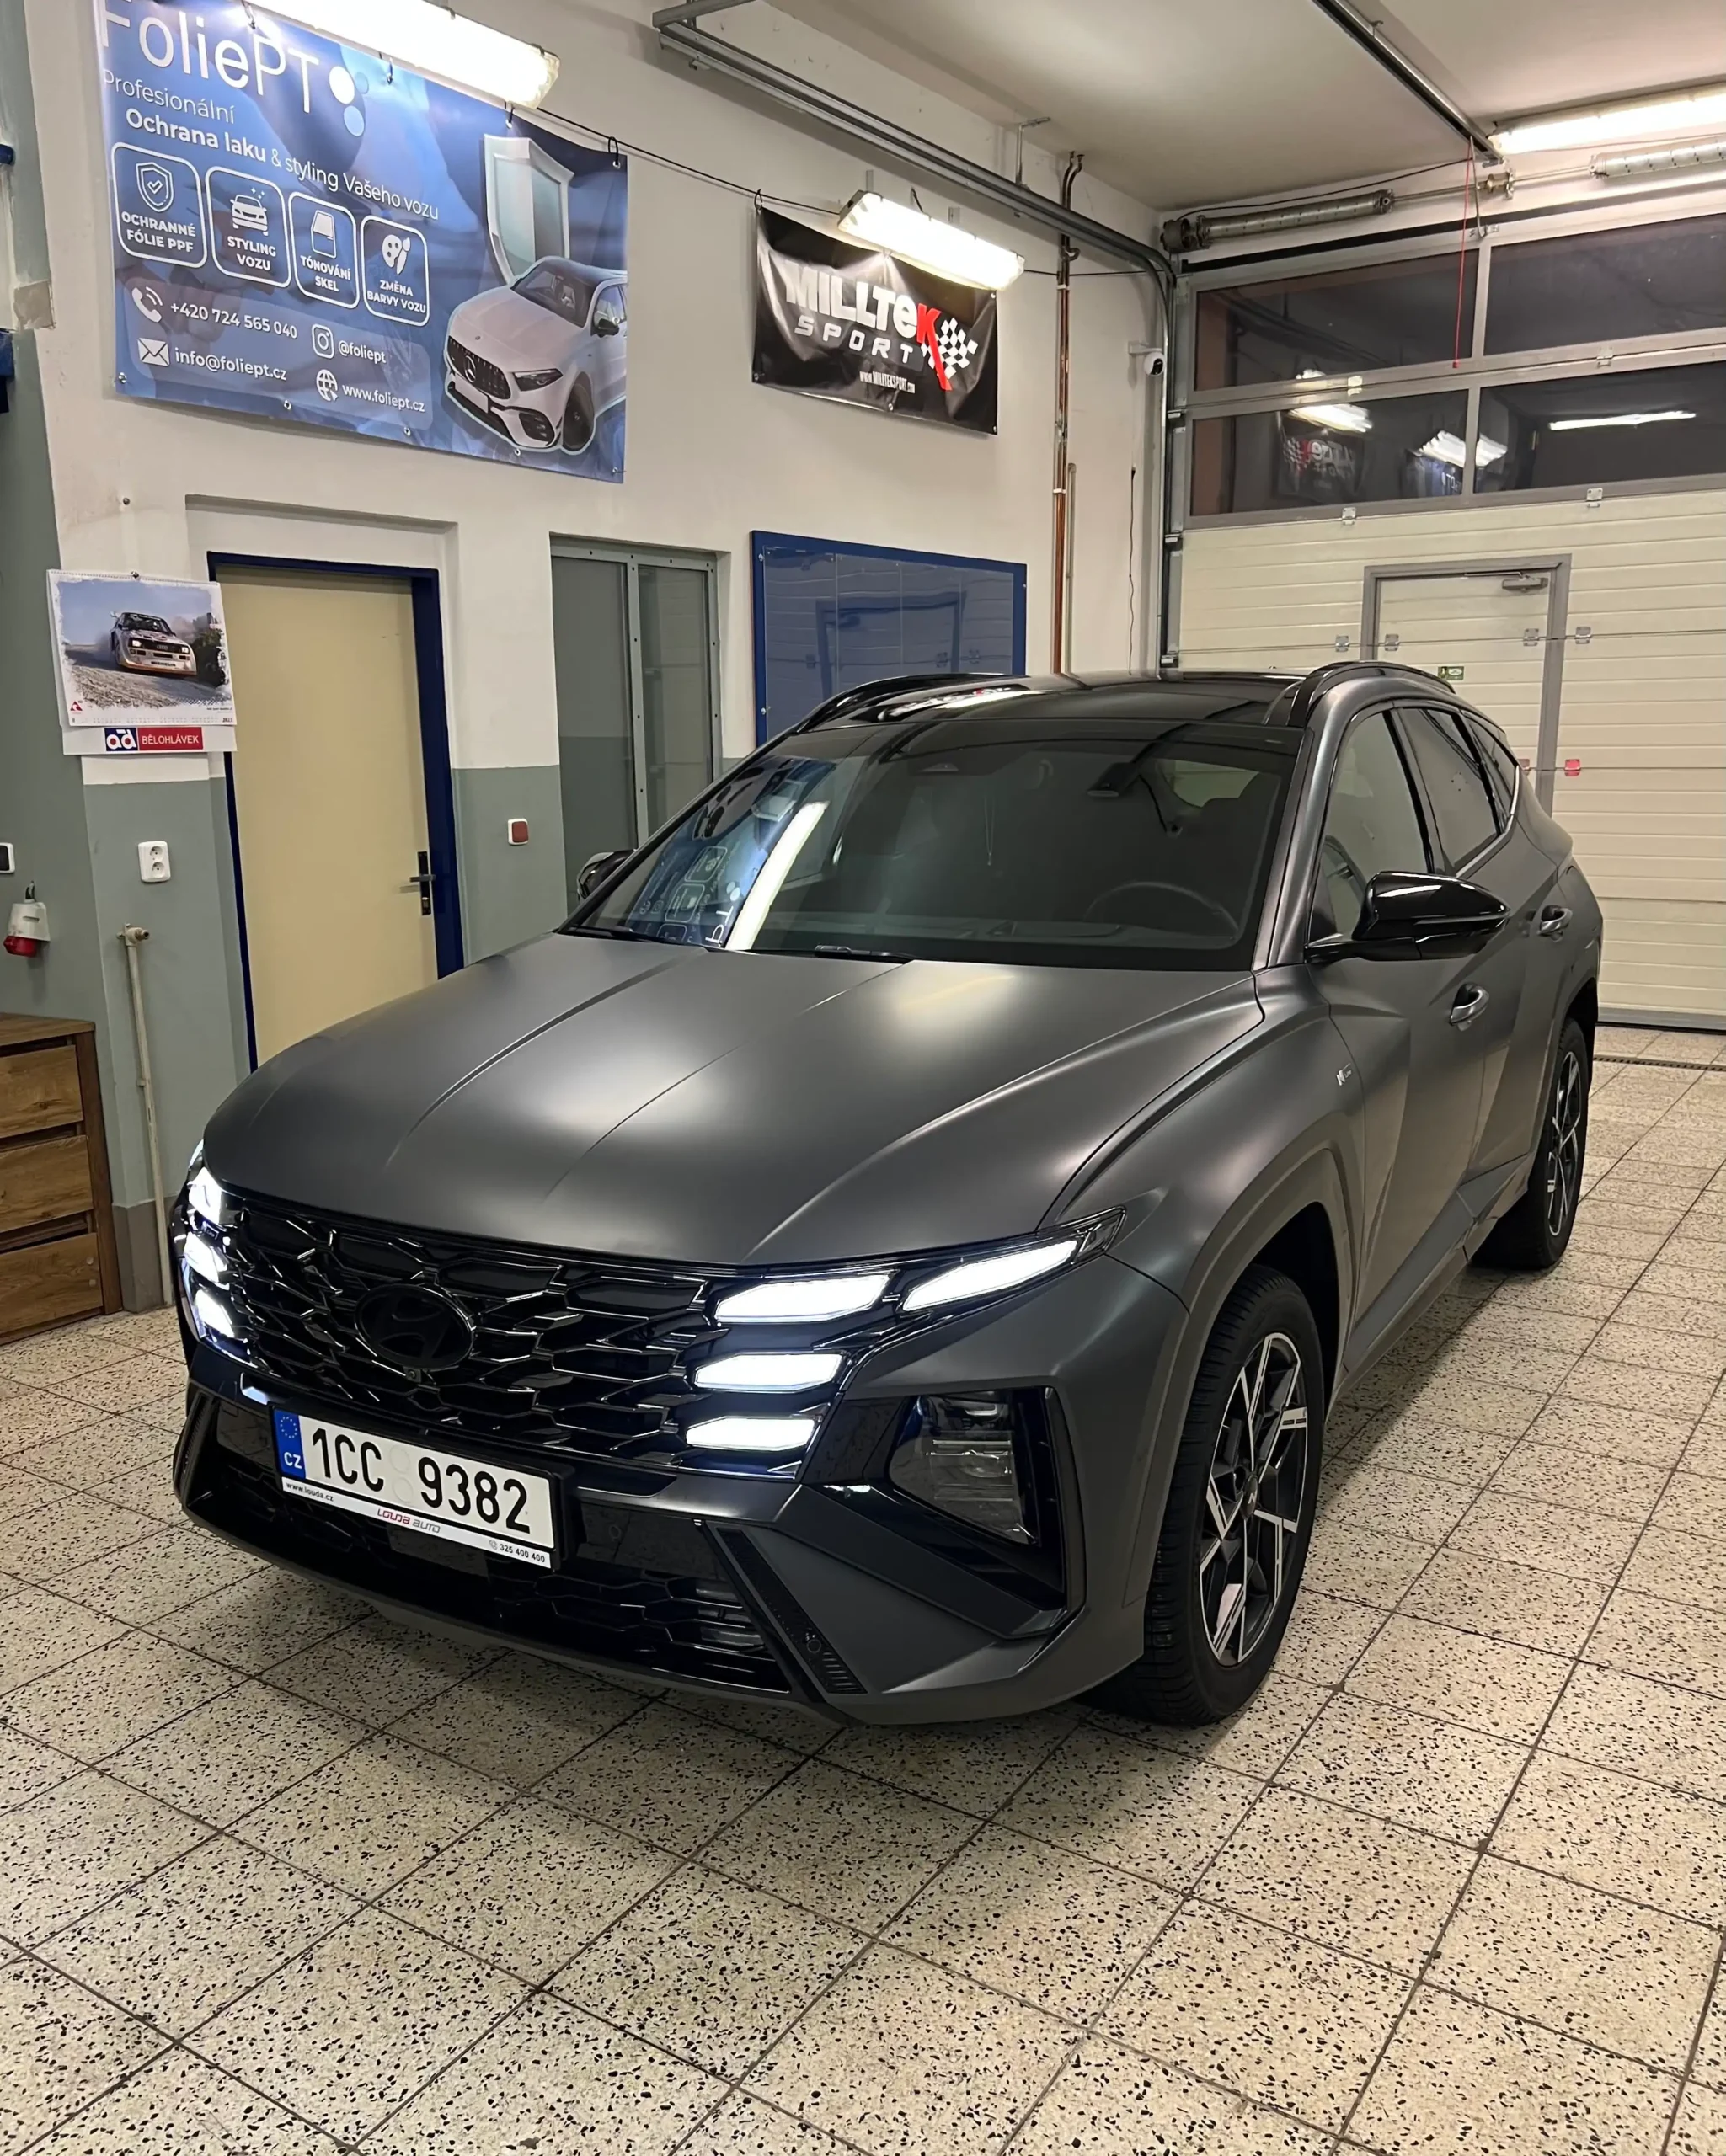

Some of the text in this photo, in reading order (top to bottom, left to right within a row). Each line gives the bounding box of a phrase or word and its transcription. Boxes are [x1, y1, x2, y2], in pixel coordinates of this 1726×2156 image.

[102, 69, 235, 125] Profesionální
[126, 108, 439, 220] Ochrana laku & styling Vašeho vozu
[121, 211, 196, 237] OCHRANNÉ
[126, 228, 194, 253] FÓLIE PPF
[227, 236, 277, 257] STYLING
[237, 253, 271, 271] VOZU
[300, 254, 351, 281] TÓNOVÁNÍ
[315, 275, 339, 292] SKEL
[380, 279, 414, 297] ZMĚNA
[366, 289, 426, 315] BARVY VOZU
[170, 302, 297, 339] +420 724 565 040
[794, 315, 913, 364] SPORT
[174, 346, 287, 382] info@foliept.cz
[339, 340, 387, 365] @foliept
[342, 384, 425, 413] www.foliept.cz
[142, 734, 199, 745] BĚLOHLÁVEK
[284, 1451, 302, 1470] CZ
[286, 1481, 334, 1502] www.louda.cz
[313, 1428, 531, 1534] 1CC 9382
[500, 1543, 546, 1563] 325 400 400
